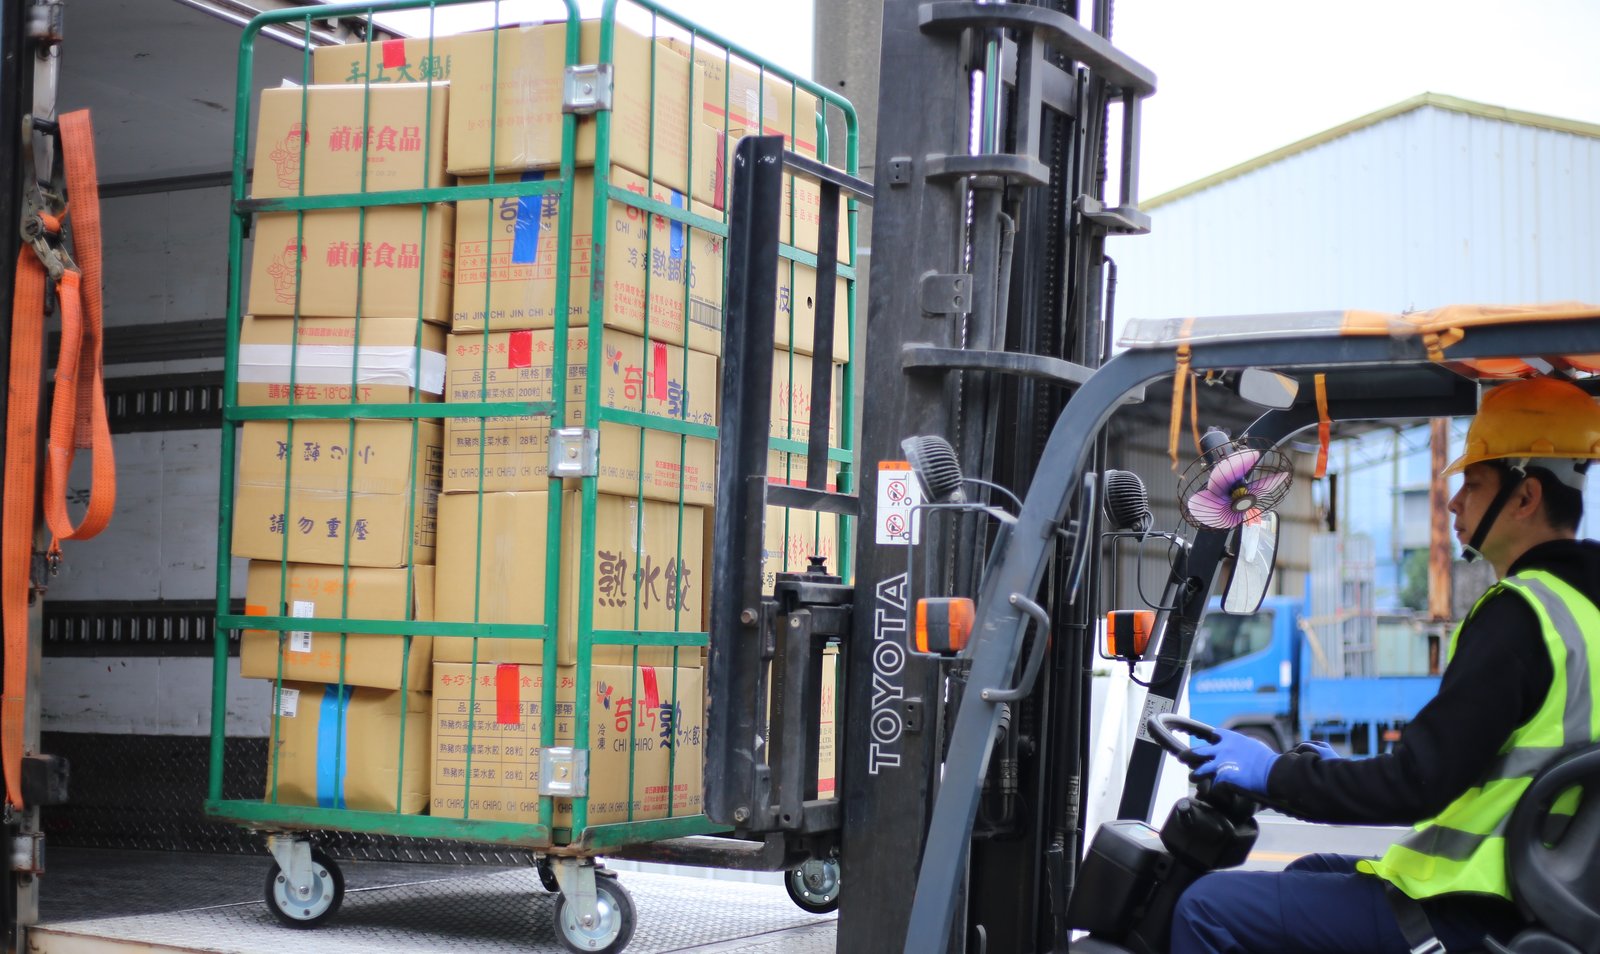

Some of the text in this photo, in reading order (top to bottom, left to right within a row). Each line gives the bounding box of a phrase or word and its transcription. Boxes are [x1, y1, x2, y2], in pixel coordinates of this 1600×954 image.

[491, 310, 505, 318] CHI
[510, 308, 524, 317] JIN
[528, 307, 543, 316] CHI
[269, 514, 370, 541] 請勿重壓
[869, 572, 908, 775] TOYOTA
